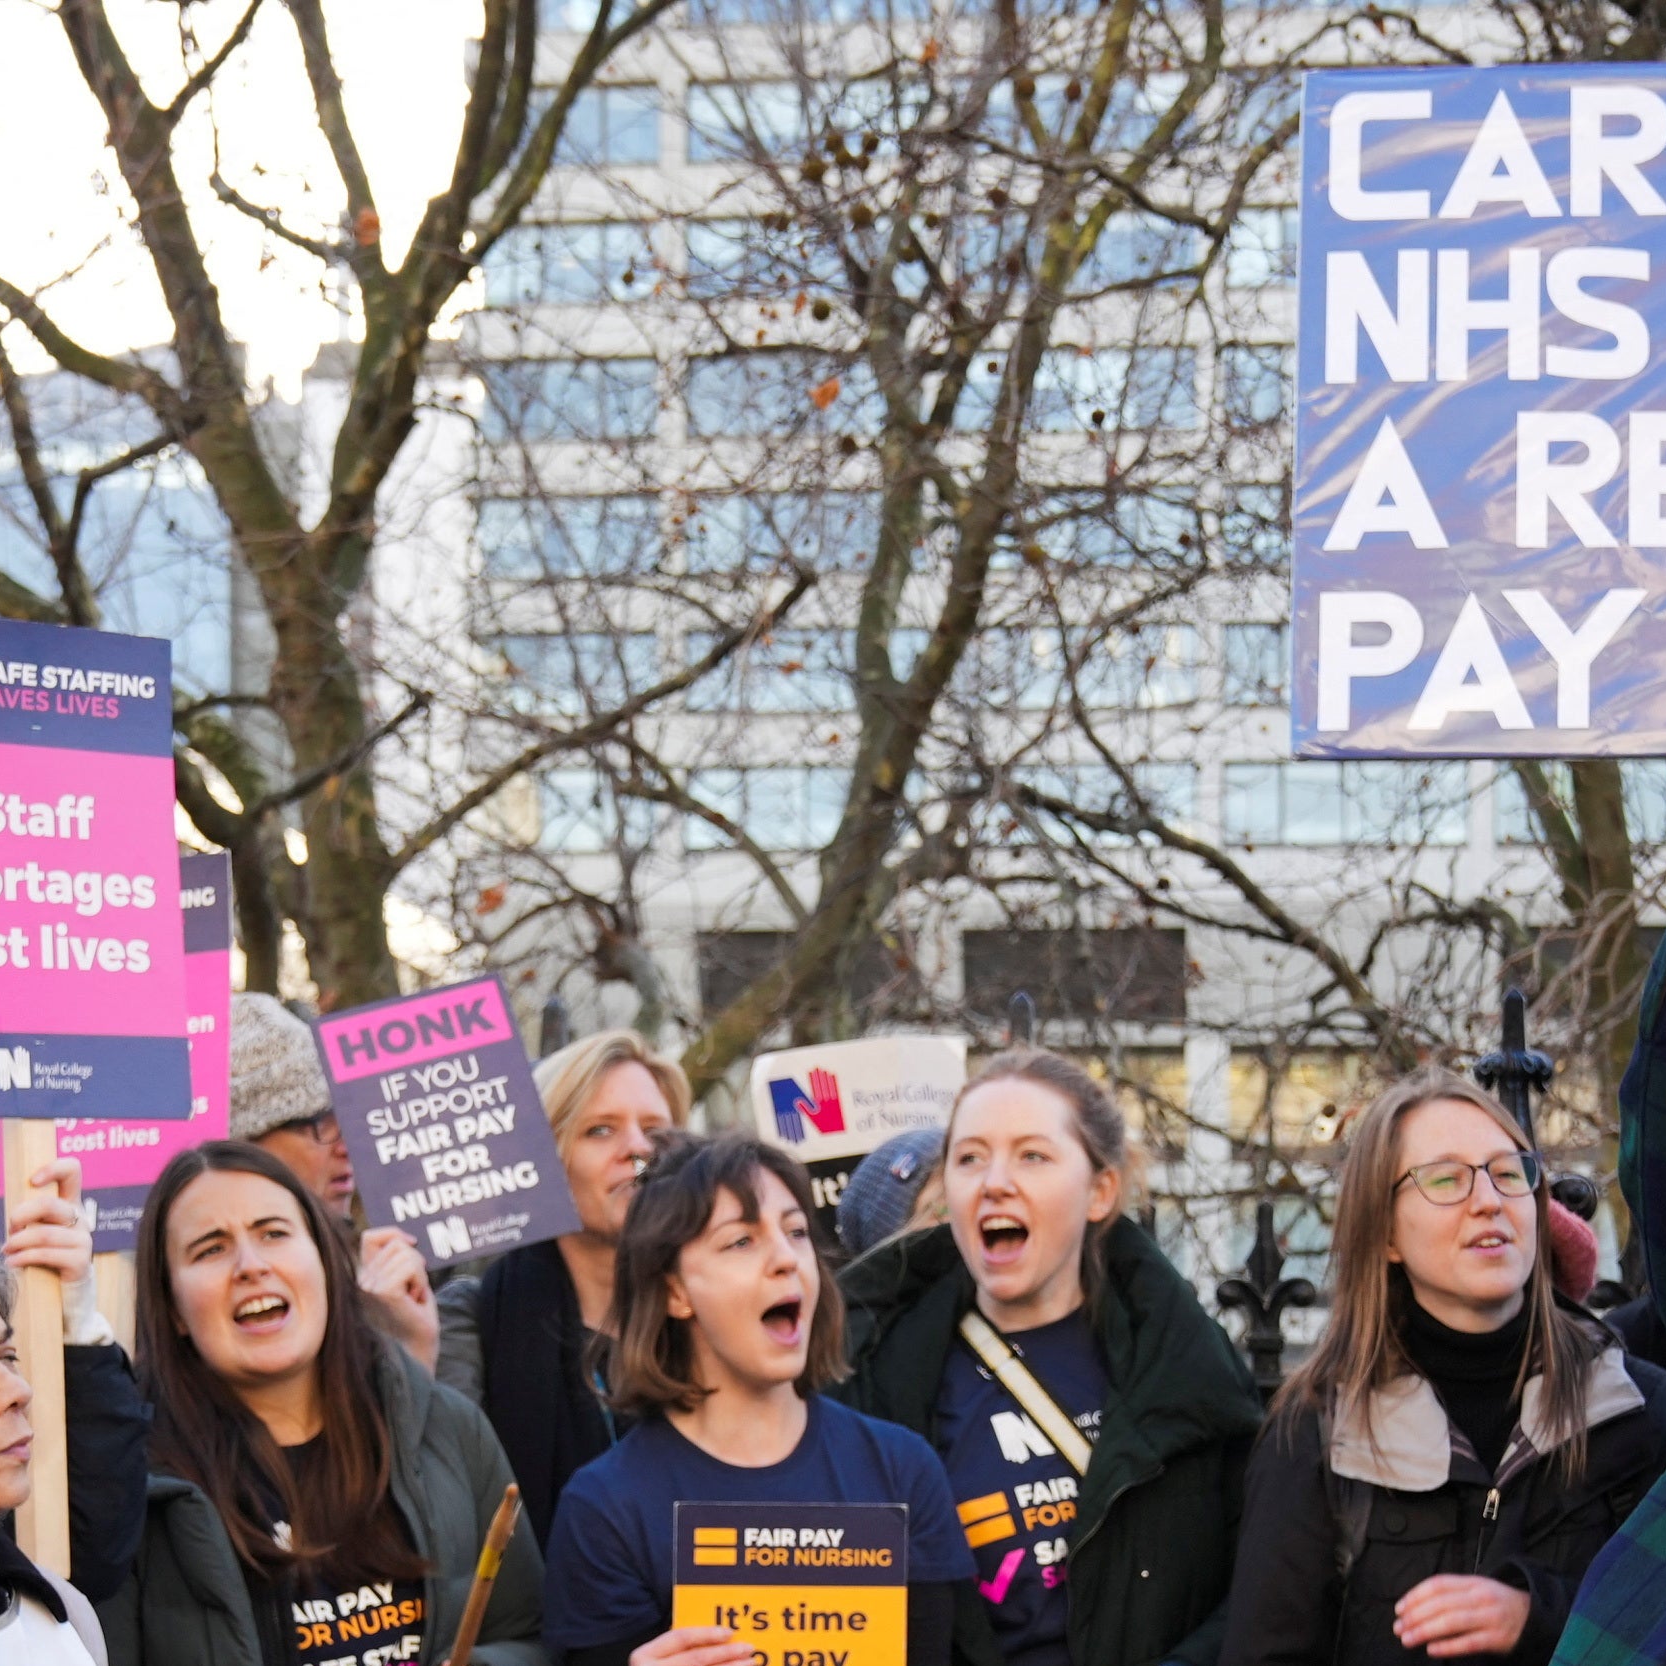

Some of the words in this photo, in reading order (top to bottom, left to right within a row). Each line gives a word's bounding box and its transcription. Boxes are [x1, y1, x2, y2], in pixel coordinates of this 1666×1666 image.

[1325, 245, 1650, 384] NHS
[1322, 414, 1450, 552] A
[1316, 589, 1648, 732] PAY
[41, 666, 156, 698] STAFFING
[56, 693, 119, 719] LIVES
[40, 923, 151, 973] lives
[336, 998, 496, 1067] HONK
[34, 1061, 59, 1077] Royal
[60, 1062, 93, 1080] College
[34, 1079, 45, 1090] of
[46, 1077, 82, 1094] Nursing
[379, 1072, 408, 1102] IF
[411, 1054, 480, 1093] YOU
[366, 1075, 508, 1136] SUPPORT
[60, 1129, 106, 1153] cost
[109, 1125, 160, 1149] lives
[375, 1123, 453, 1165] FAIR
[454, 1104, 516, 1144] PAY
[421, 1143, 492, 1183] FOR
[390, 1161, 539, 1223] NURSING
[1014, 1476, 1080, 1508] FAIR
[1022, 1501, 1077, 1531] FOR
[744, 1528, 797, 1547] FAIR
[800, 1528, 844, 1547] PAY
[744, 1548, 789, 1566] FOR
[794, 1548, 893, 1567] NURSING
[292, 1599, 336, 1624] AIR
[336, 1582, 393, 1617] PAY
[715, 1604, 769, 1631] It's
[782, 1603, 868, 1631] time
